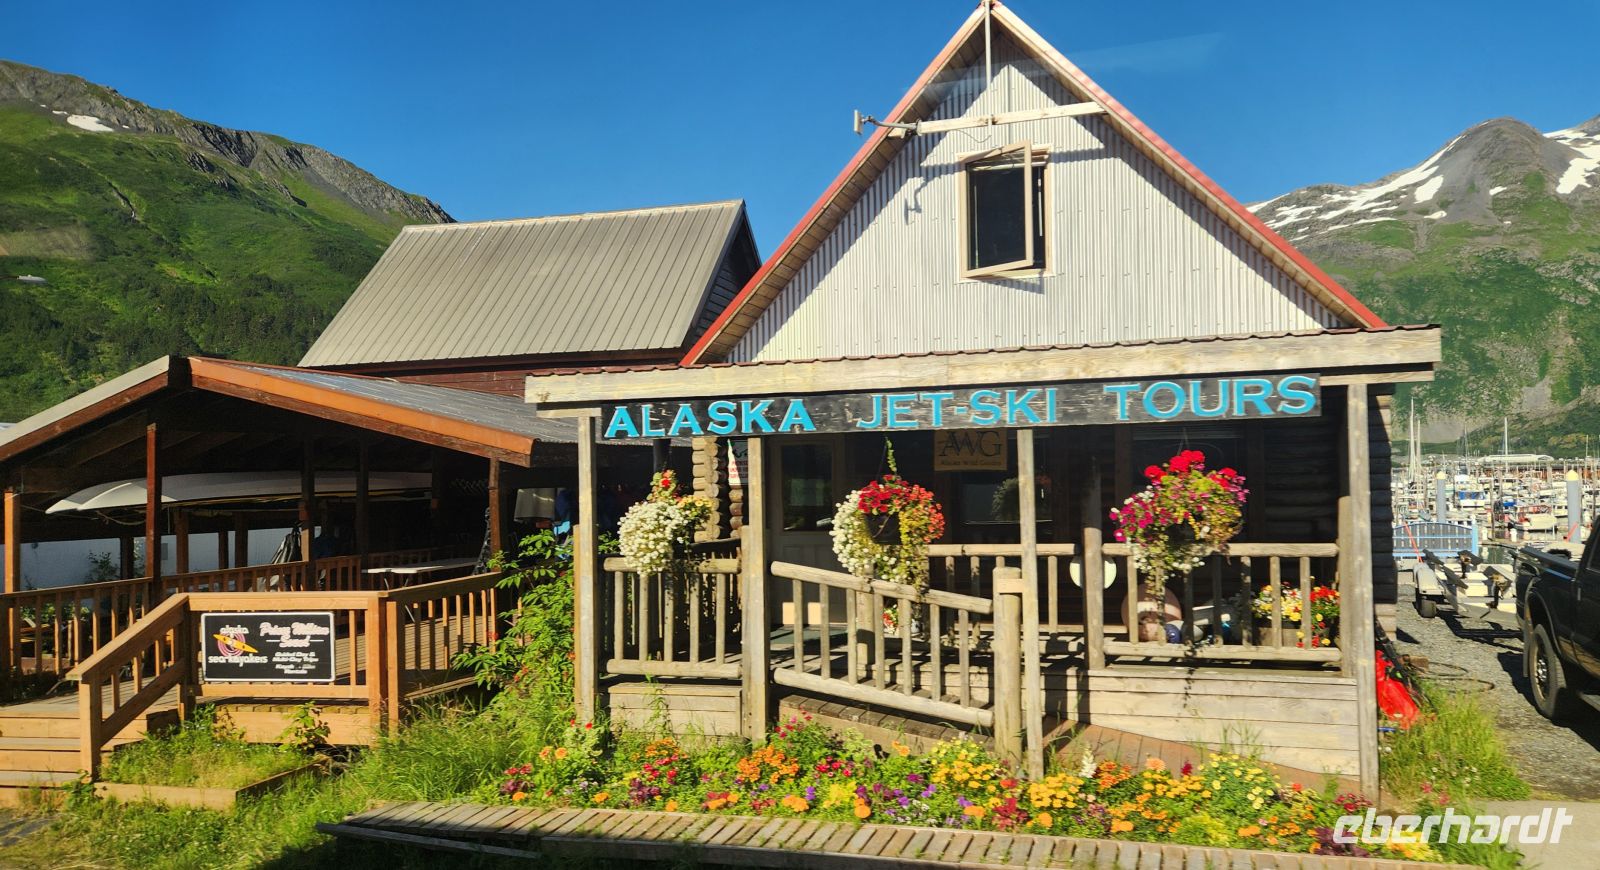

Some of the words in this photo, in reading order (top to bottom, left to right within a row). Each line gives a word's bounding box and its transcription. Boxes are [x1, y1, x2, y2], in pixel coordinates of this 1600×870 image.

[604, 399, 817, 438] ALASKA
[856, 388, 1058, 428] JET-SKI
[1103, 375, 1317, 421] TOURS
[938, 430, 1002, 457] AWG
